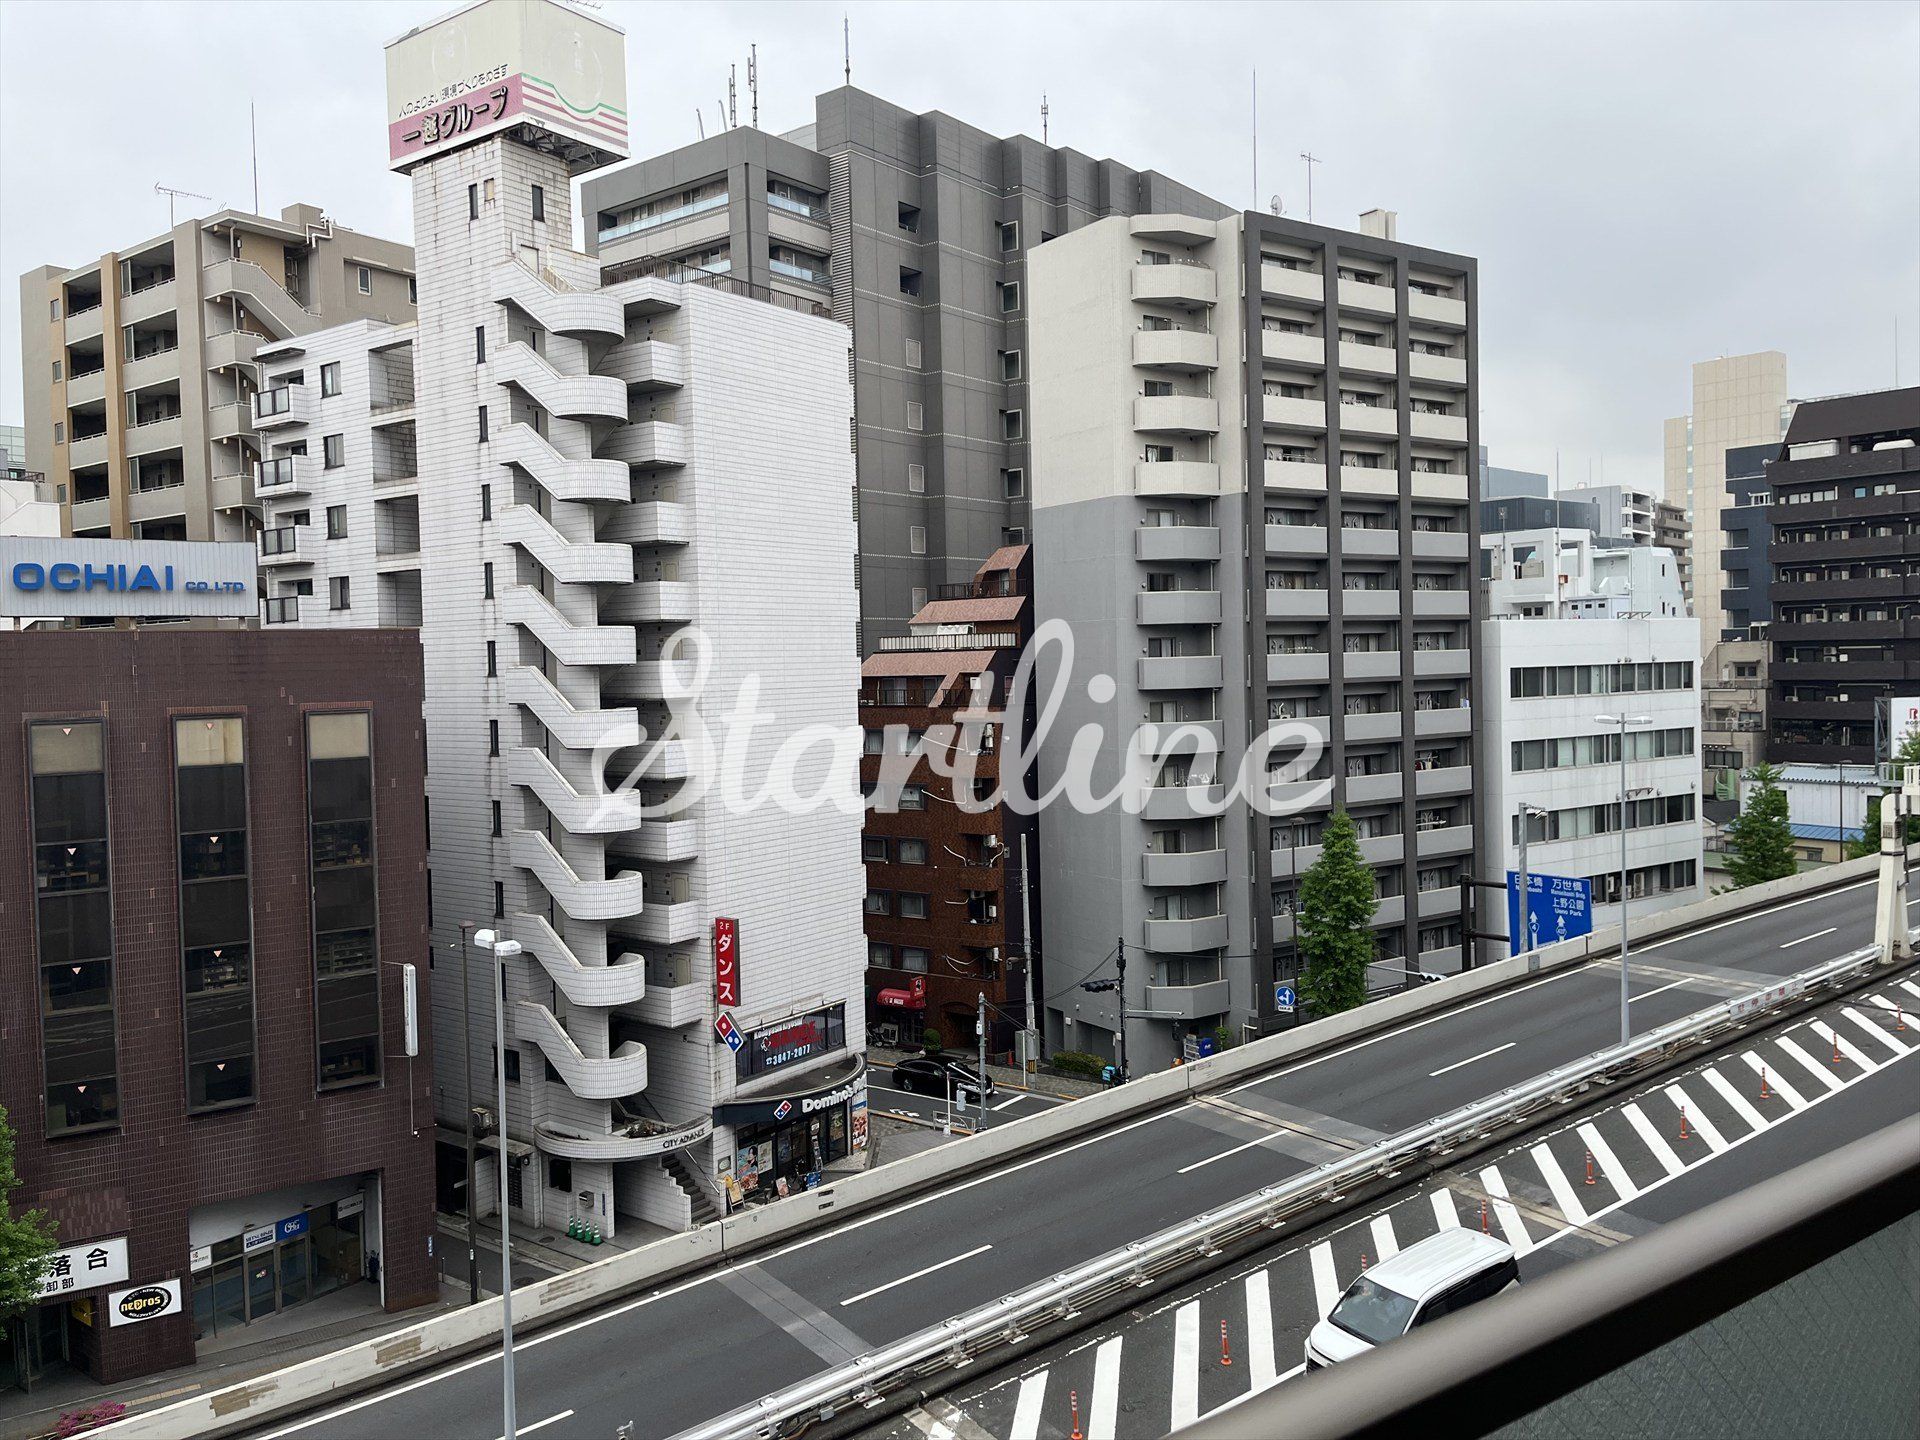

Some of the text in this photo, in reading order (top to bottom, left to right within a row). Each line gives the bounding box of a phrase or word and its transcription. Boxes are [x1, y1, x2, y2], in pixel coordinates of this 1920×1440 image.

[13, 563, 173, 592] OCHIAI
[1552, 878, 1583, 892] 万世橋
[1552, 897, 1584, 910] 上野公園
[720, 921, 730, 930] 2F
[718, 934, 733, 1001] ダンス
[802, 1084, 853, 1113] Domino's
[663, 1138, 679, 1149] CITY
[50, 1247, 109, 1278] 落合
